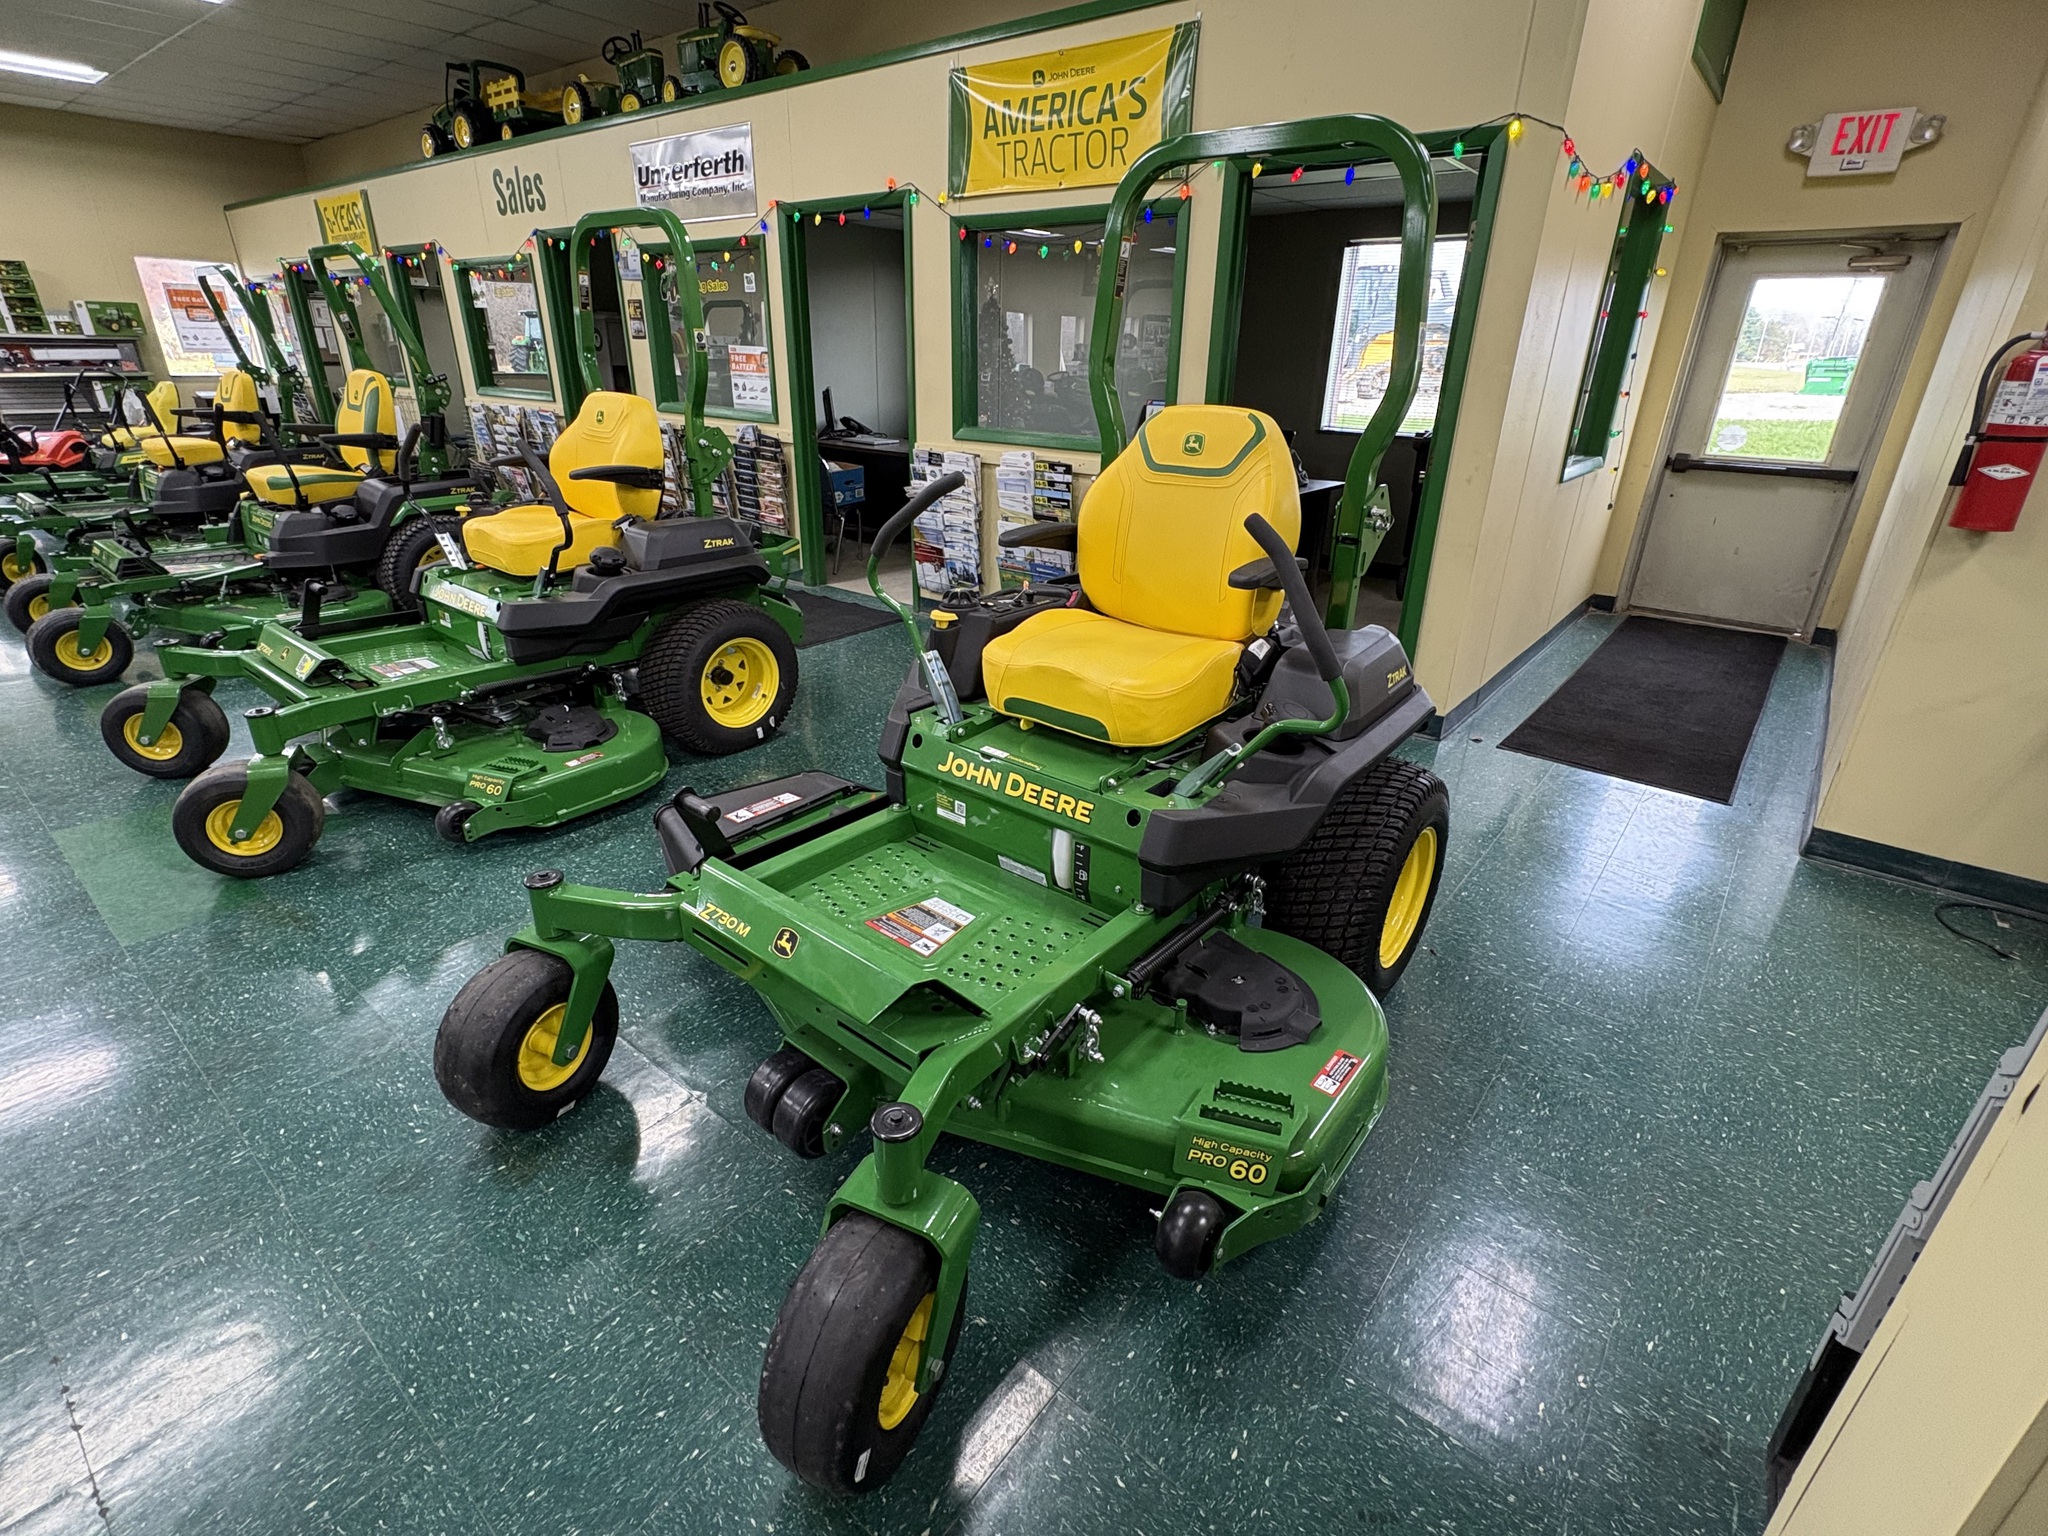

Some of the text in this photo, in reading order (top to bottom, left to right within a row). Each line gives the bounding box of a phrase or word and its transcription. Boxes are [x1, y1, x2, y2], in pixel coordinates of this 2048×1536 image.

[1048, 66, 1096, 82] JOHN DEERE
[983, 76, 1148, 140] AMERICA'S
[1831, 112, 1902, 156] EXIT
[997, 126, 1130, 179] TRACTOR
[492, 165, 546, 217] Sales
[640, 181, 748, 205] Manufacturing Company, Inc.
[323, 201, 366, 235] 6-YEAR
[707, 279, 729, 292] Sales
[730, 354, 747, 363] FREE
[731, 362, 758, 372] BATTERY
[450, 486, 475, 495] ZTRAK
[703, 537, 735, 549] ZTRAK
[434, 585, 488, 618] JOHN DEERE
[1386, 664, 1408, 689] ZTRAK
[469, 780, 503, 796] PRO 60
[937, 751, 1095, 824] JOHN DEERE
[700, 902, 752, 938] Z730M
[1192, 1136, 1273, 1163] High Capacity
[1187, 1149, 1269, 1185] PRO 60
